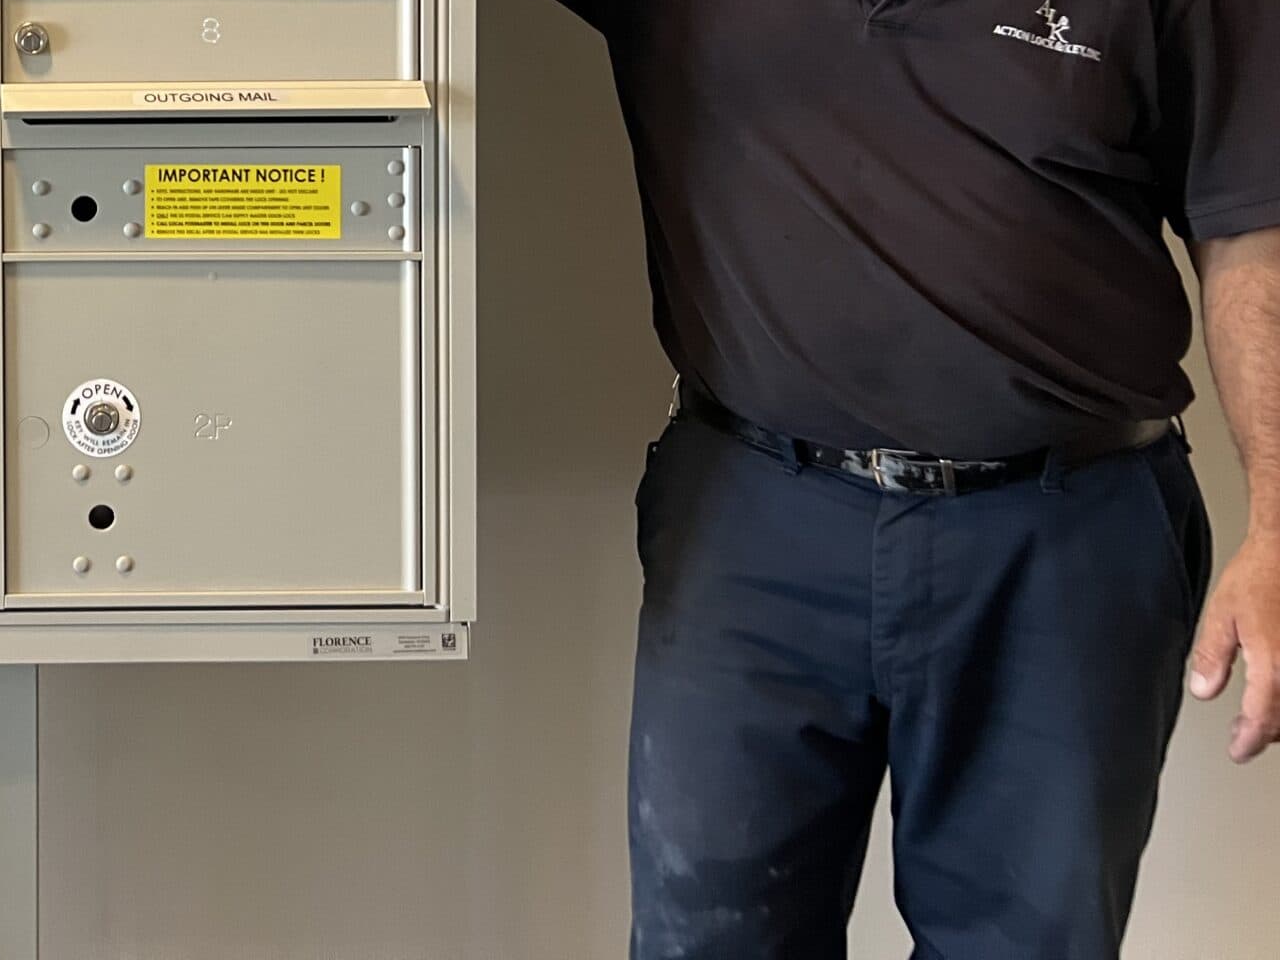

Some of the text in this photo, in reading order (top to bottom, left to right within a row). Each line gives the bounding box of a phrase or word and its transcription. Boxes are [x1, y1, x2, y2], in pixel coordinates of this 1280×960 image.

[201, 17, 221, 44] 8
[993, 25, 1029, 42] ACTION
[144, 92, 278, 103] OUTGOING MAIL
[158, 168, 251, 183] IMPORTANT
[256, 168, 316, 183] NOTICE
[82, 384, 122, 399] OPEN
[74, 420, 84, 433] KEY
[83, 434, 99, 446] WILL
[102, 428, 128, 447] REMAIN
[193, 412, 234, 440] 2P
[66, 419, 139, 454] LOCK AFTER OPENING DOOR
[313, 636, 371, 647] FLORENCE
